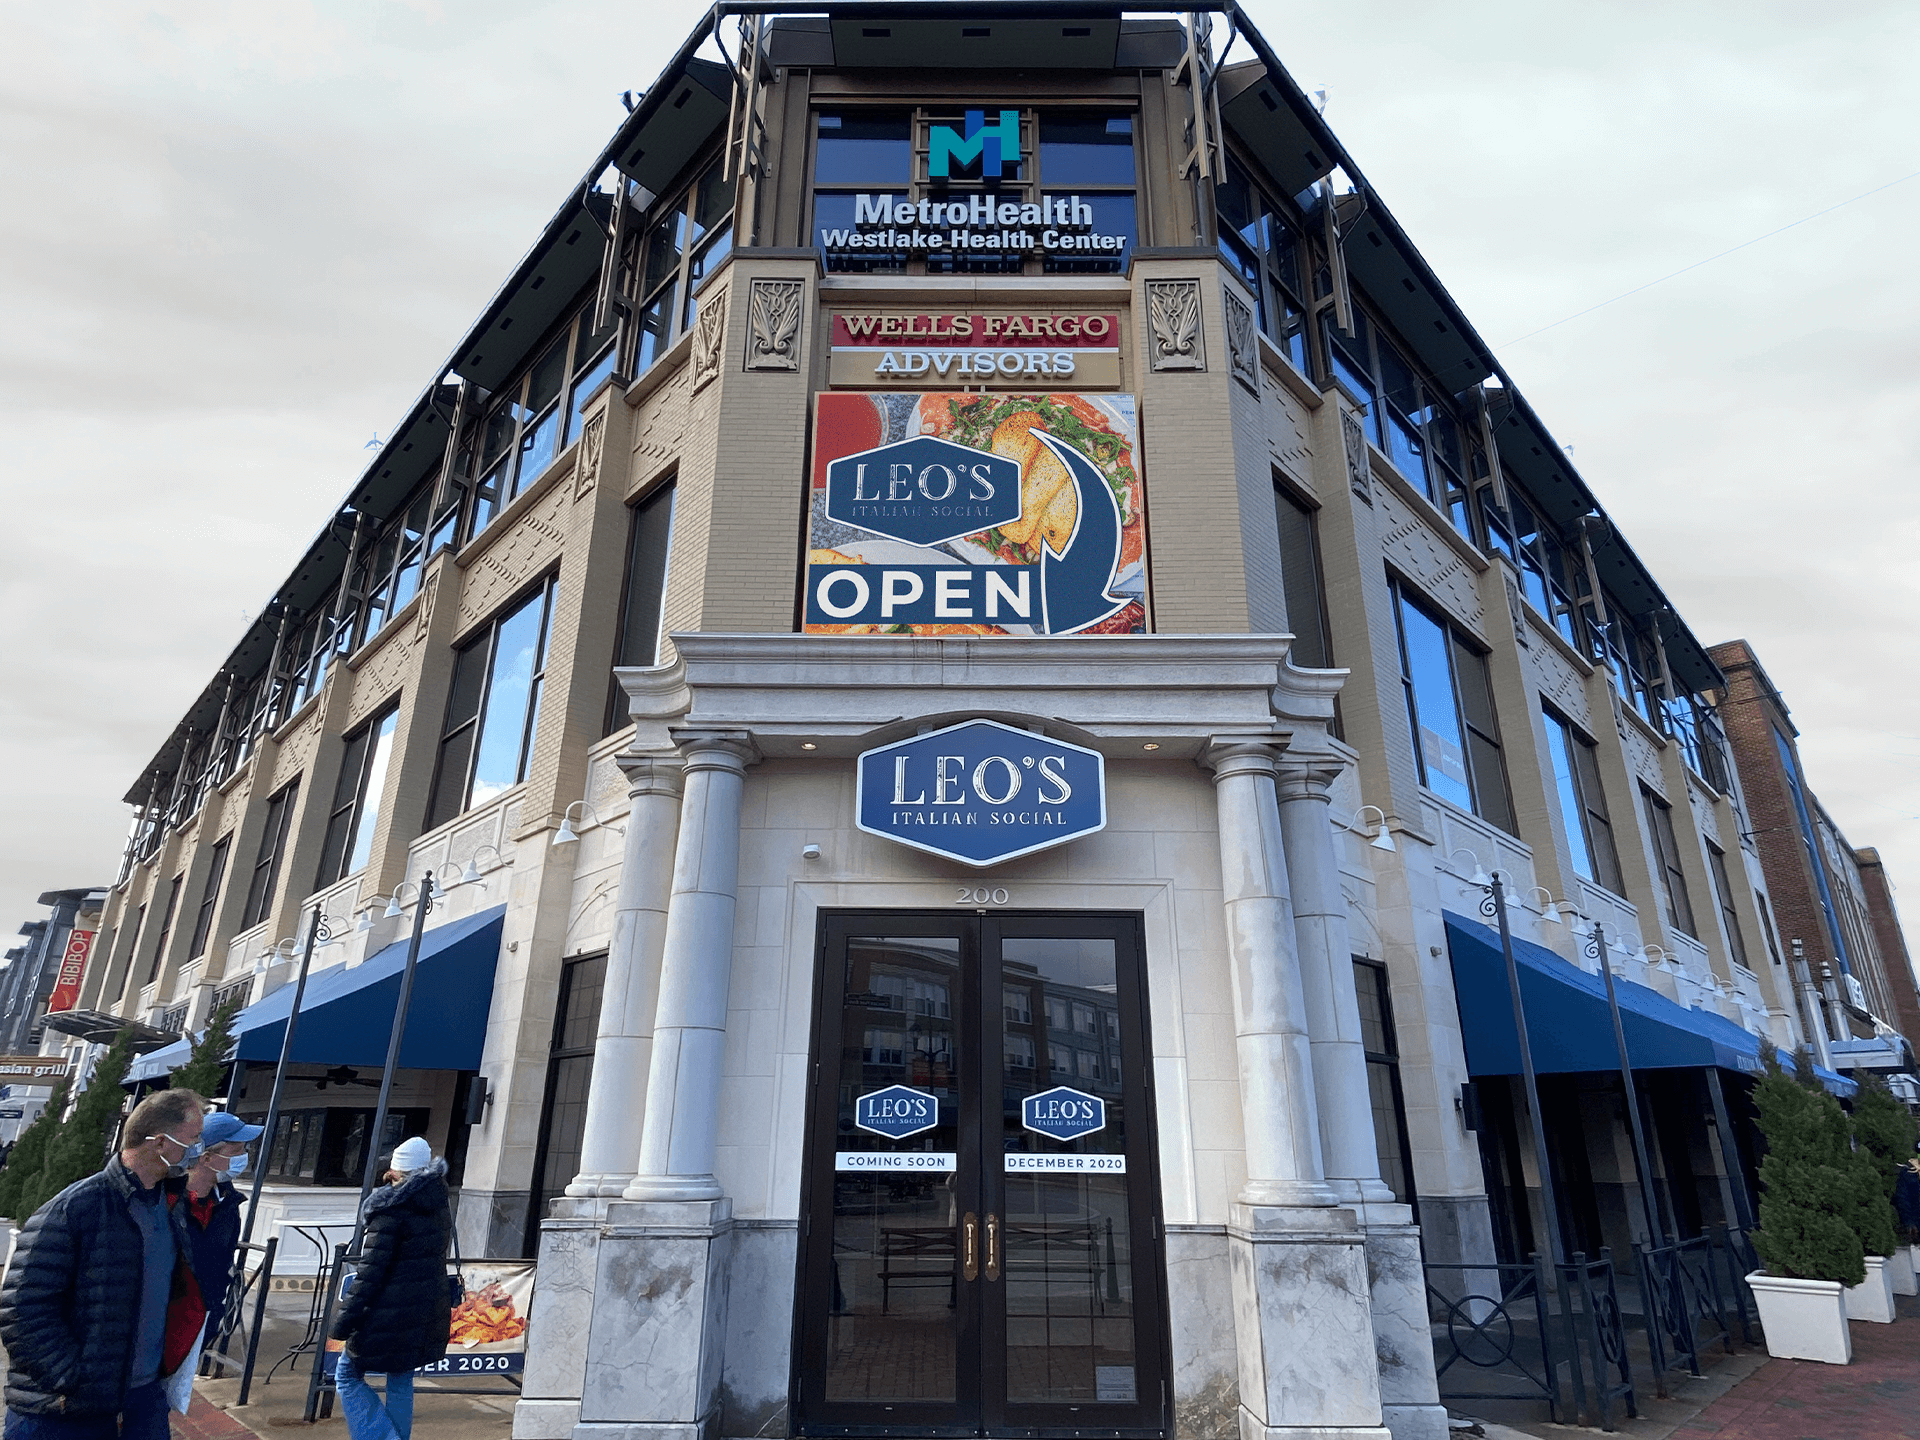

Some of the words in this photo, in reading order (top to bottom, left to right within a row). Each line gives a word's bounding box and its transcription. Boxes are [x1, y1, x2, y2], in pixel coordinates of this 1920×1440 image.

[855, 194, 1093, 226] MetroHealth
[821, 229, 943, 248] Westlake
[951, 229, 1034, 249] Health
[1042, 230, 1127, 250] Center
[841, 315, 973, 336] WELLS
[982, 315, 1110, 337] FARGO
[875, 352, 1075, 374] ADVISORS
[852, 463, 996, 501] LEO'S
[852, 505, 921, 517] ITALIAN
[931, 505, 994, 517] SOCIAL
[816, 569, 1031, 618] OPEN
[890, 755, 1072, 805] LEO'S
[892, 811, 978, 825] ITALIAN
[990, 811, 1067, 825] SOCIAL
[955, 887, 1010, 905] 200
[59, 931, 90, 986] BIBIBOP
[34, 1064, 66, 1078] grill
[867, 1098, 928, 1118] LEO'S
[1034, 1100, 1094, 1119] LEO'S
[847, 1156, 902, 1167] COMING
[907, 1157, 946, 1167] SOON
[1008, 1158, 1084, 1168] DECEMBER
[1089, 1159, 1123, 1169] 2020
[458, 1356, 510, 1371] 2020
